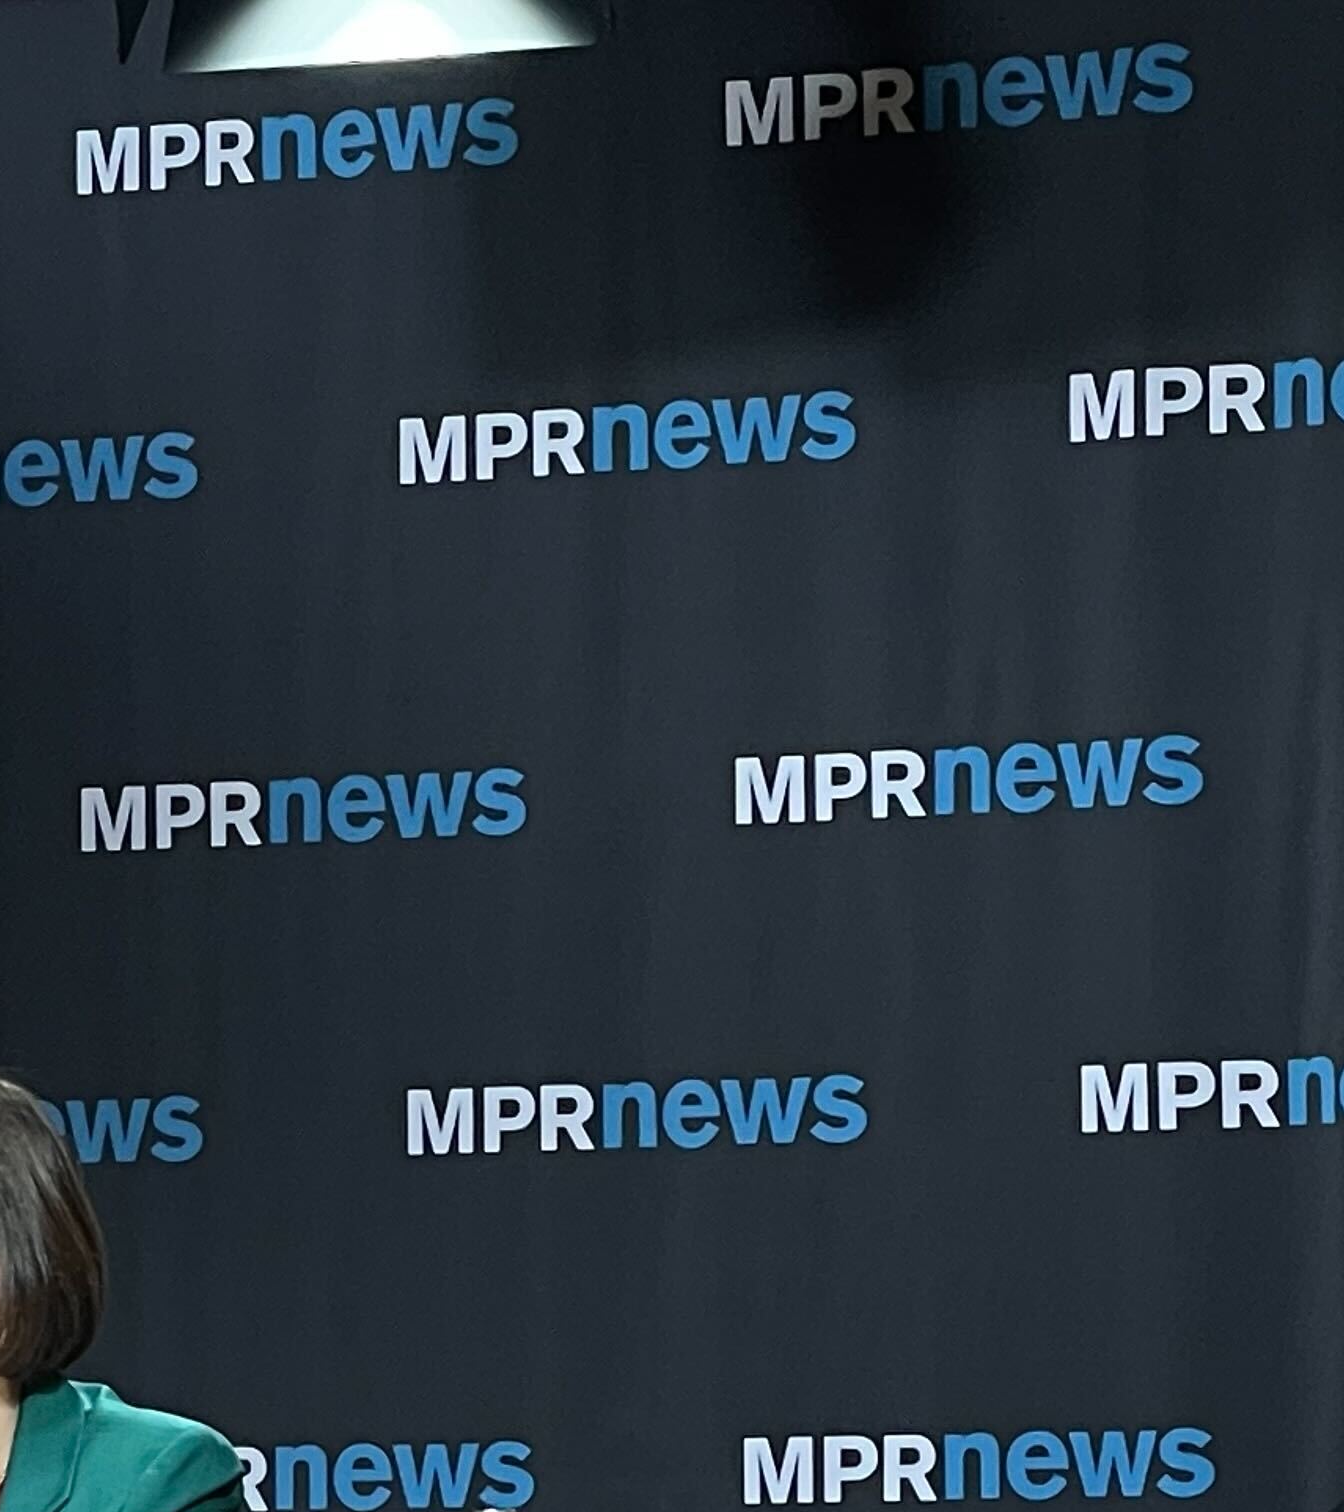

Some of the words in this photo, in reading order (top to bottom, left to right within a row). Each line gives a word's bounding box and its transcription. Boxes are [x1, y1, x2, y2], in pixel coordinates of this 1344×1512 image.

[725, 43, 1194, 147] MPRnews
[75, 97, 518, 196] MPRnews
[399, 390, 856, 485] MPRnews
[80, 766, 527, 853] MPRnews
[734, 734, 1204, 825] MPRnews
[406, 1074, 868, 1156] MPRnews
[742, 1427, 1216, 1505] MPRnews
